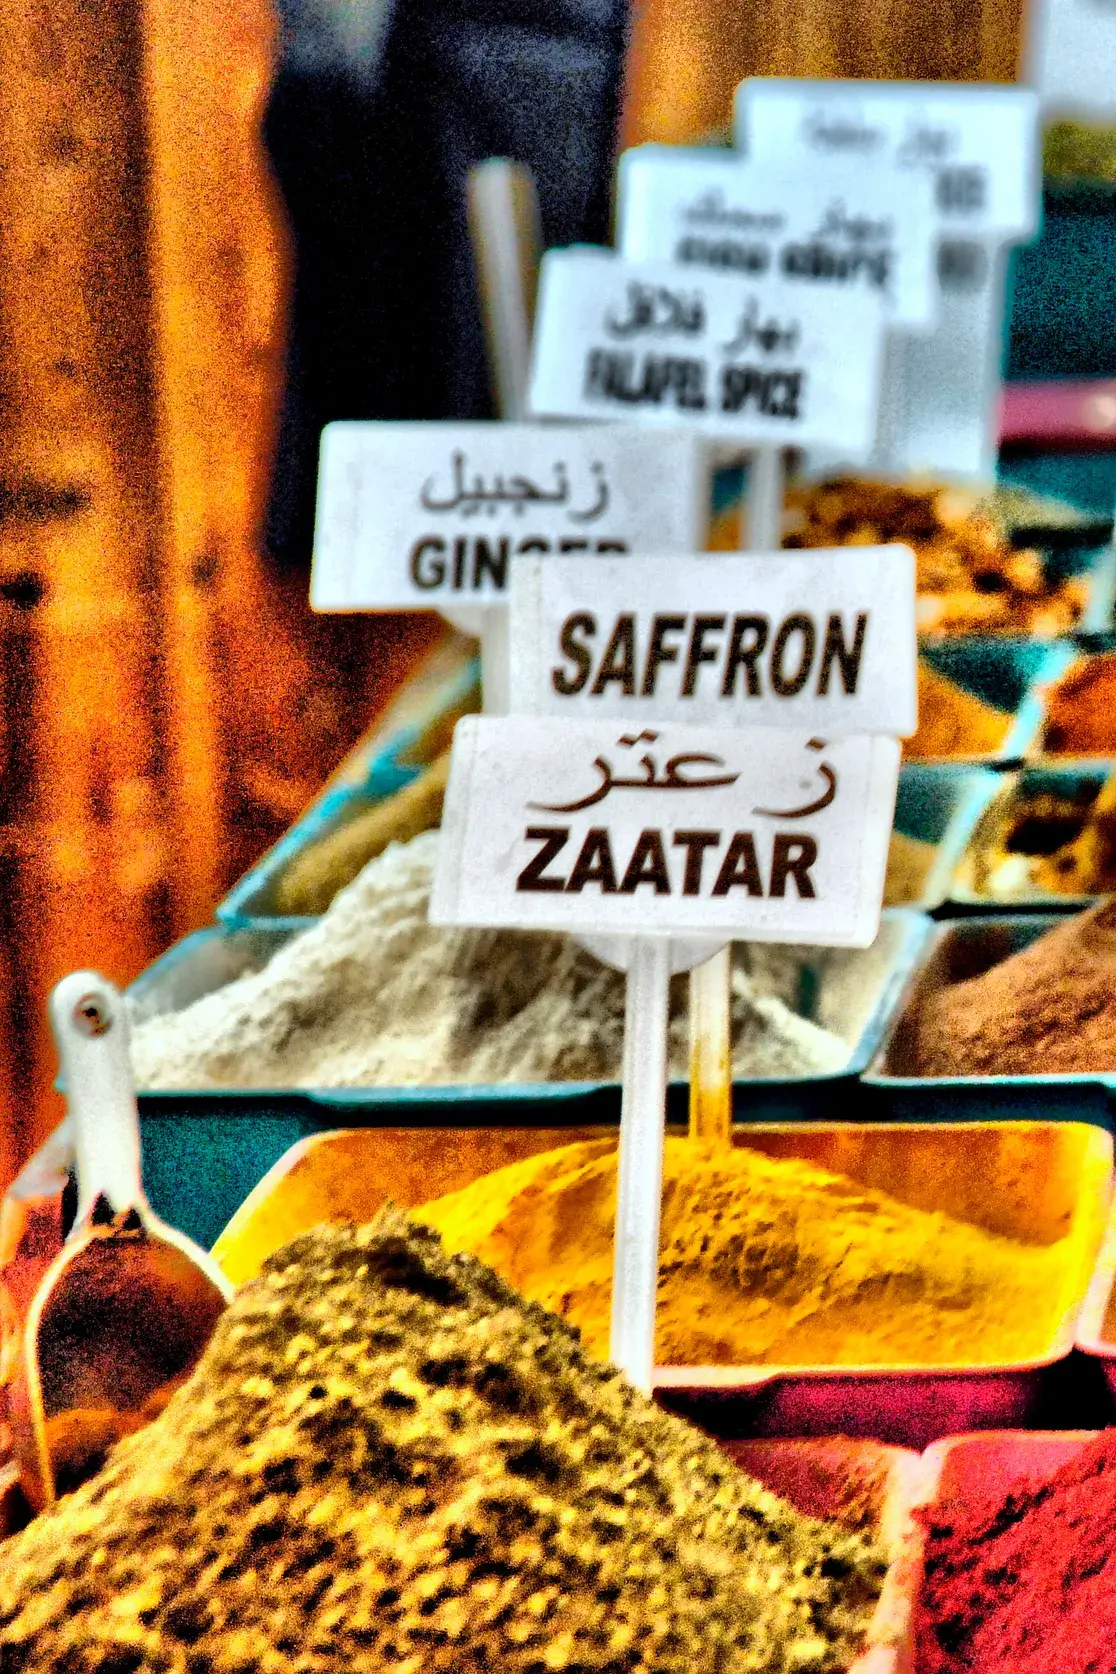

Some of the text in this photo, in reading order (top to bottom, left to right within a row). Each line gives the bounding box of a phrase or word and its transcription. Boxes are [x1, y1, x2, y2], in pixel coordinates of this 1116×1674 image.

[421, 450, 610, 524] زنجبيل
[409, 533, 630, 593] GIN
[551, 611, 868, 698] SAFFRON
[515, 825, 819, 900] ZAATAR
